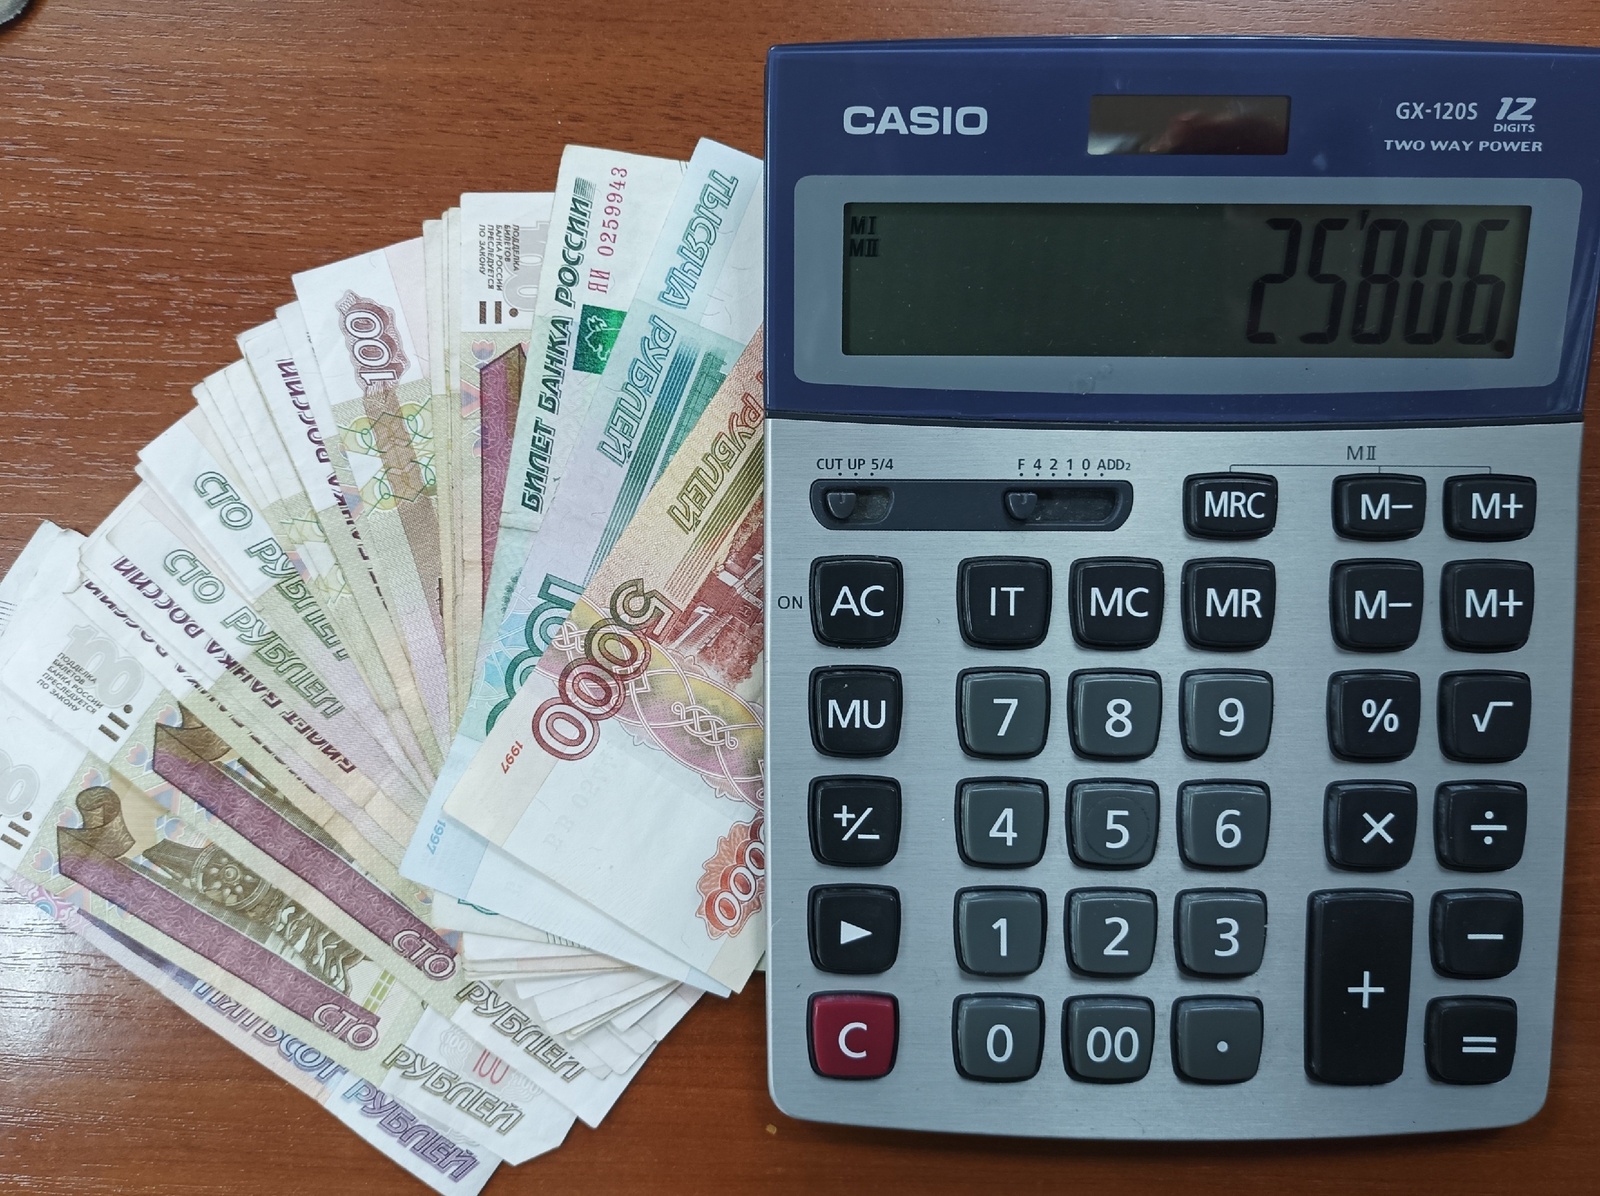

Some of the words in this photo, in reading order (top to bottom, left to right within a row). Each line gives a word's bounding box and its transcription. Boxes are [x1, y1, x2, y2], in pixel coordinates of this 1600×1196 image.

[843, 105, 988, 135] CASIO
[1396, 102, 1478, 120] GX-120S
[1493, 123, 1536, 133] DIGITS
[1495, 97, 1537, 121] 12
[1384, 139, 1426, 151] TWO
[1430, 140, 1474, 152] WAY
[1478, 141, 1543, 152] POWER
[479, 224, 486, 238] ПО
[597, 167, 628, 257] 0259943
[512, 224, 520, 272] ПОДДЕЛКА
[555, 196, 595, 307] РОССИИ
[657, 169, 739, 310] ТЫСЯЧА
[345, 310, 402, 388] 100
[537, 315, 572, 415] БАНКА
[596, 315, 677, 468] РУБЛЕЙ
[520, 417, 555, 514] БИЛЕТ
[666, 392, 764, 535] РУБЛЕЙ
[816, 458, 843, 471] CUT
[848, 458, 866, 471] UP
[871, 458, 894, 471] 5/4
[1018, 459, 1025, 470] F
[1033, 459, 1042, 470] 4
[1049, 459, 1058, 470] 2
[1066, 459, 1073, 470] 1
[1081, 459, 1091, 470] 0
[193, 471, 253, 531] СТО
[1204, 491, 1266, 519] MRC
[1471, 492, 1523, 519] M+
[163, 549, 225, 604] СТО
[111, 555, 206, 639] РОССИИ
[777, 596, 803, 610] ON
[830, 585, 885, 617] AC
[989, 587, 1024, 617] IT
[1090, 587, 1149, 618] MC
[1205, 588, 1262, 619] MR
[1465, 589, 1523, 618] M+
[47, 665, 71, 686] БАНКА
[71, 684, 104, 709] РОССИИ
[52, 659, 85, 685] БИЛЕТОВ
[57, 652, 97, 684] ПОДДЕЛКА
[532, 578, 682, 761] 5000
[36, 679, 50, 690] ПО
[49, 688, 80, 712] ЗАКОНУ
[42, 672, 97, 715] ПРЕСЛЕДУЕТСЯ
[828, 700, 886, 729] MU
[993, 699, 1018, 736] 7
[1105, 699, 1133, 738] 8
[1218, 698, 1245, 736] 9
[1361, 699, 1399, 733] %
[501, 740, 523, 774] 1997
[426, 819, 446, 855] 1997
[989, 808, 1018, 846] 4
[1105, 810, 1130, 849] 5
[1215, 809, 1242, 848] 6
[705, 818, 764, 931] 000
[991, 918, 1008, 957] 1
[1103, 917, 1129, 956] 2
[1214, 918, 1240, 957] 3
[391, 929, 457, 981] СТО
[454, 980, 587, 1084] РУБЛЕЙ
[838, 1022, 868, 1059] C
[986, 1024, 1013, 1063] 0
[1086, 1026, 1140, 1064] 00
[312, 1002, 380, 1051] СТО
[380, 1043, 526, 1136] РУБЛЕЙ
[342, 1078, 481, 1183] РУБЛЕЙ
